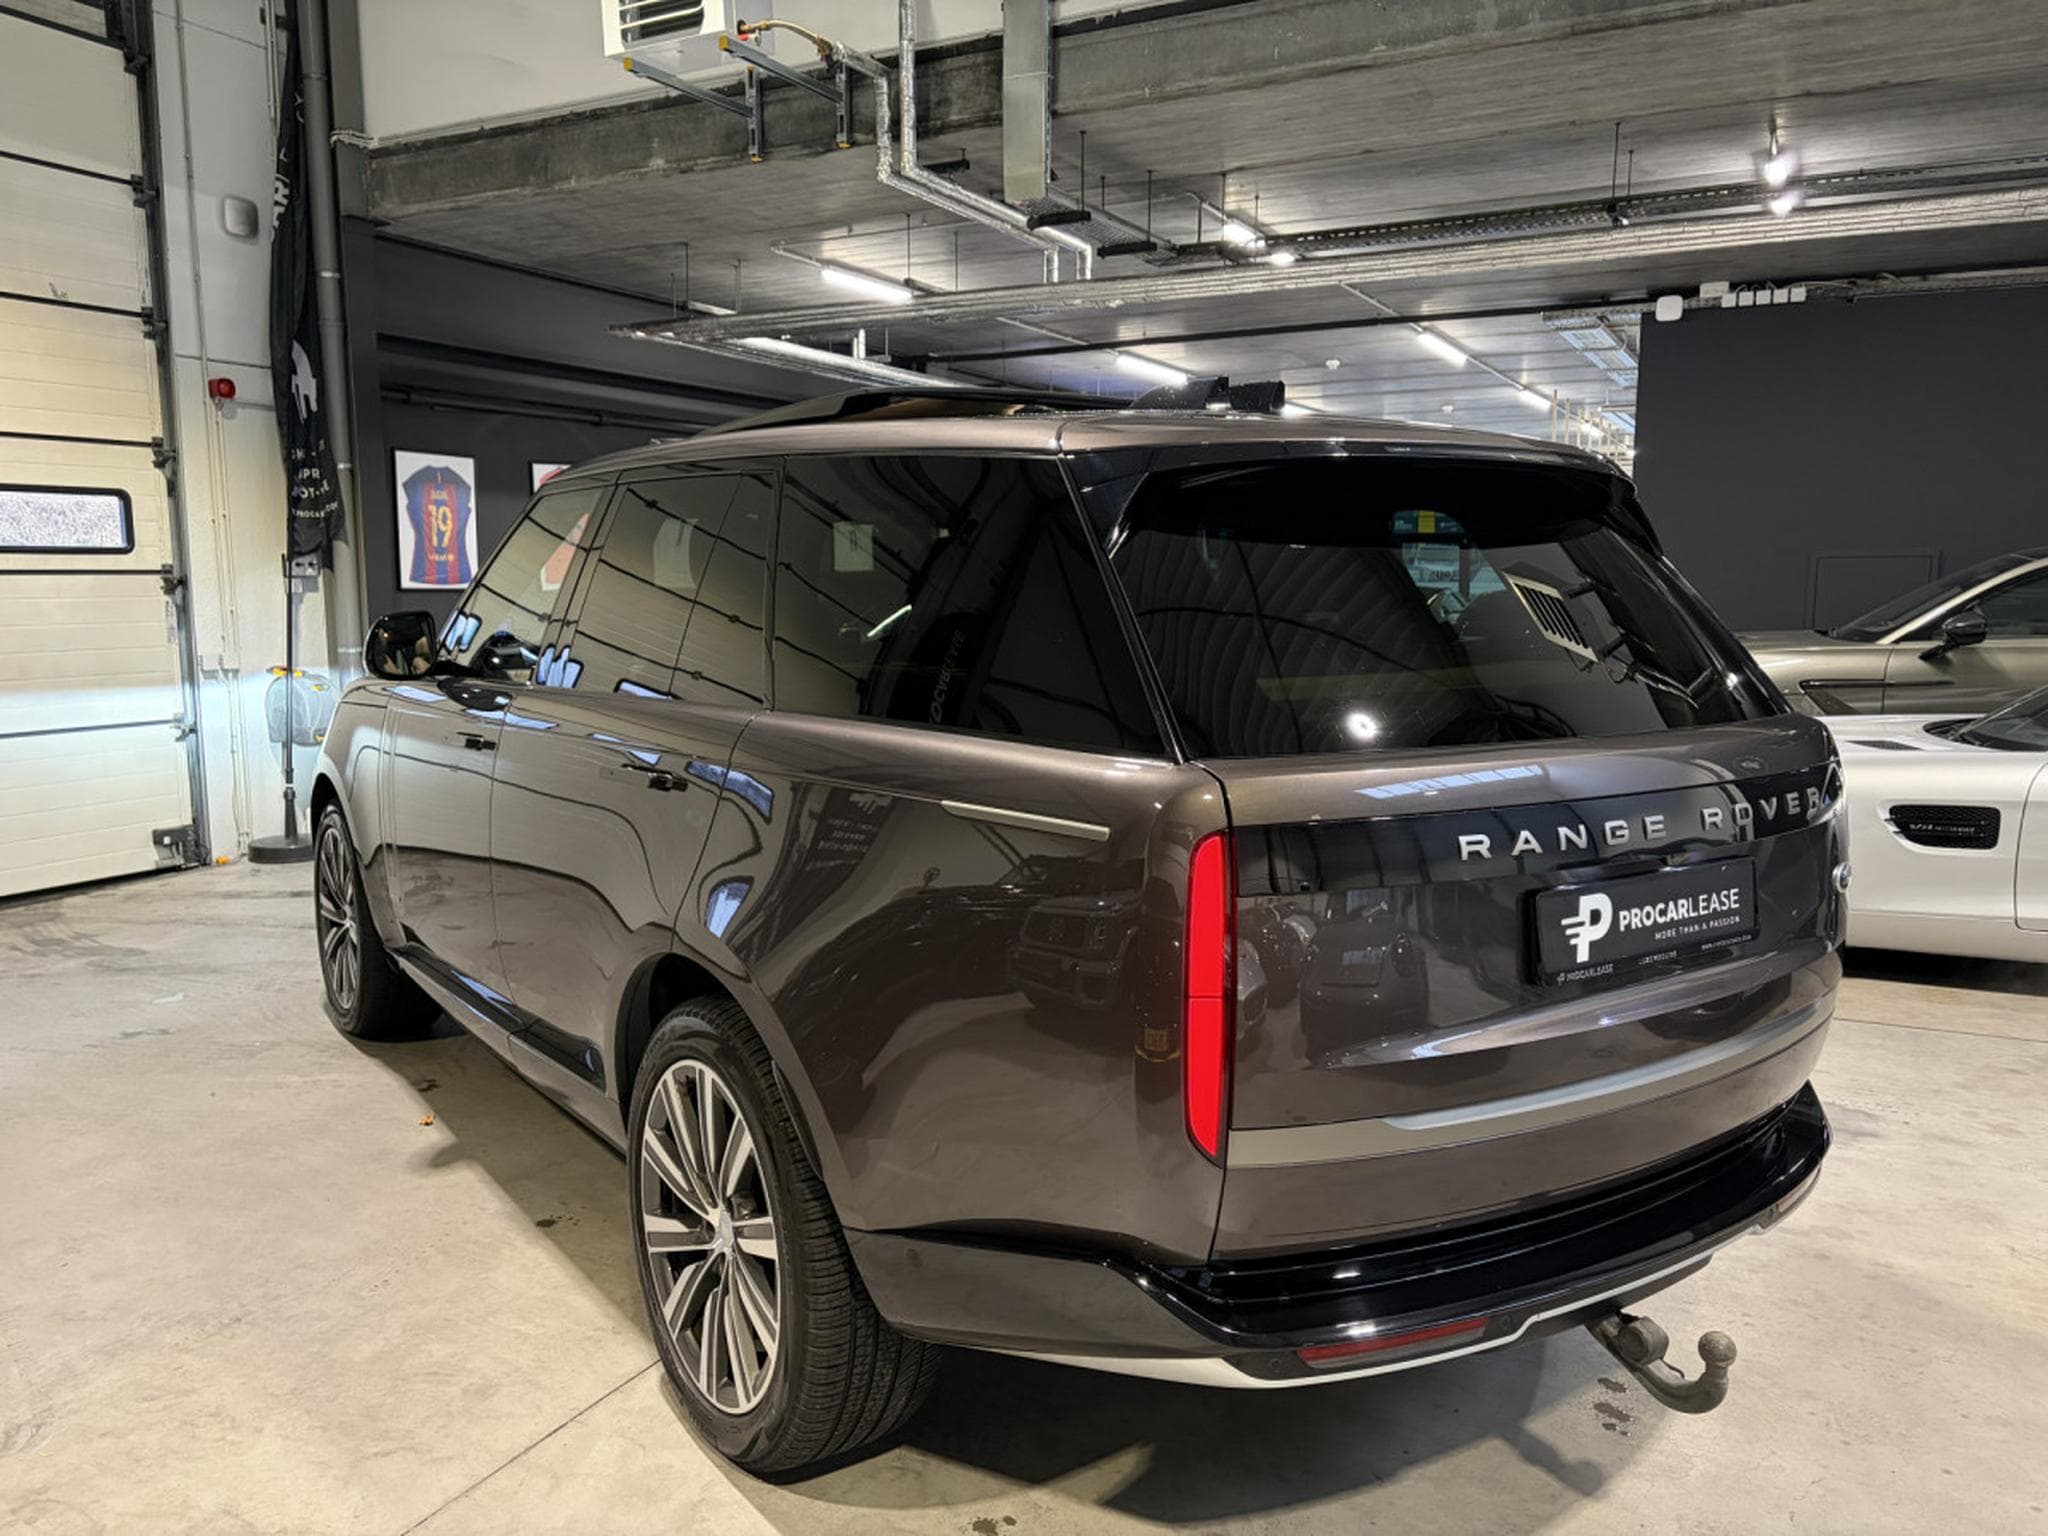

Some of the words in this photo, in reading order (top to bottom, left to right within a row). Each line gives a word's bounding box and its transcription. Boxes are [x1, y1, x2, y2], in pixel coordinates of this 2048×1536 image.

[428, 504, 452, 548] 19
[1458, 815, 1666, 861] RANGE
[1701, 787, 1821, 831] ROVER
[1618, 888, 1740, 933] PROCARLEASE
[1655, 927, 1678, 941] MORE
[1679, 923, 1700, 935] THAN
[1709, 915, 1741, 930] PASSION
